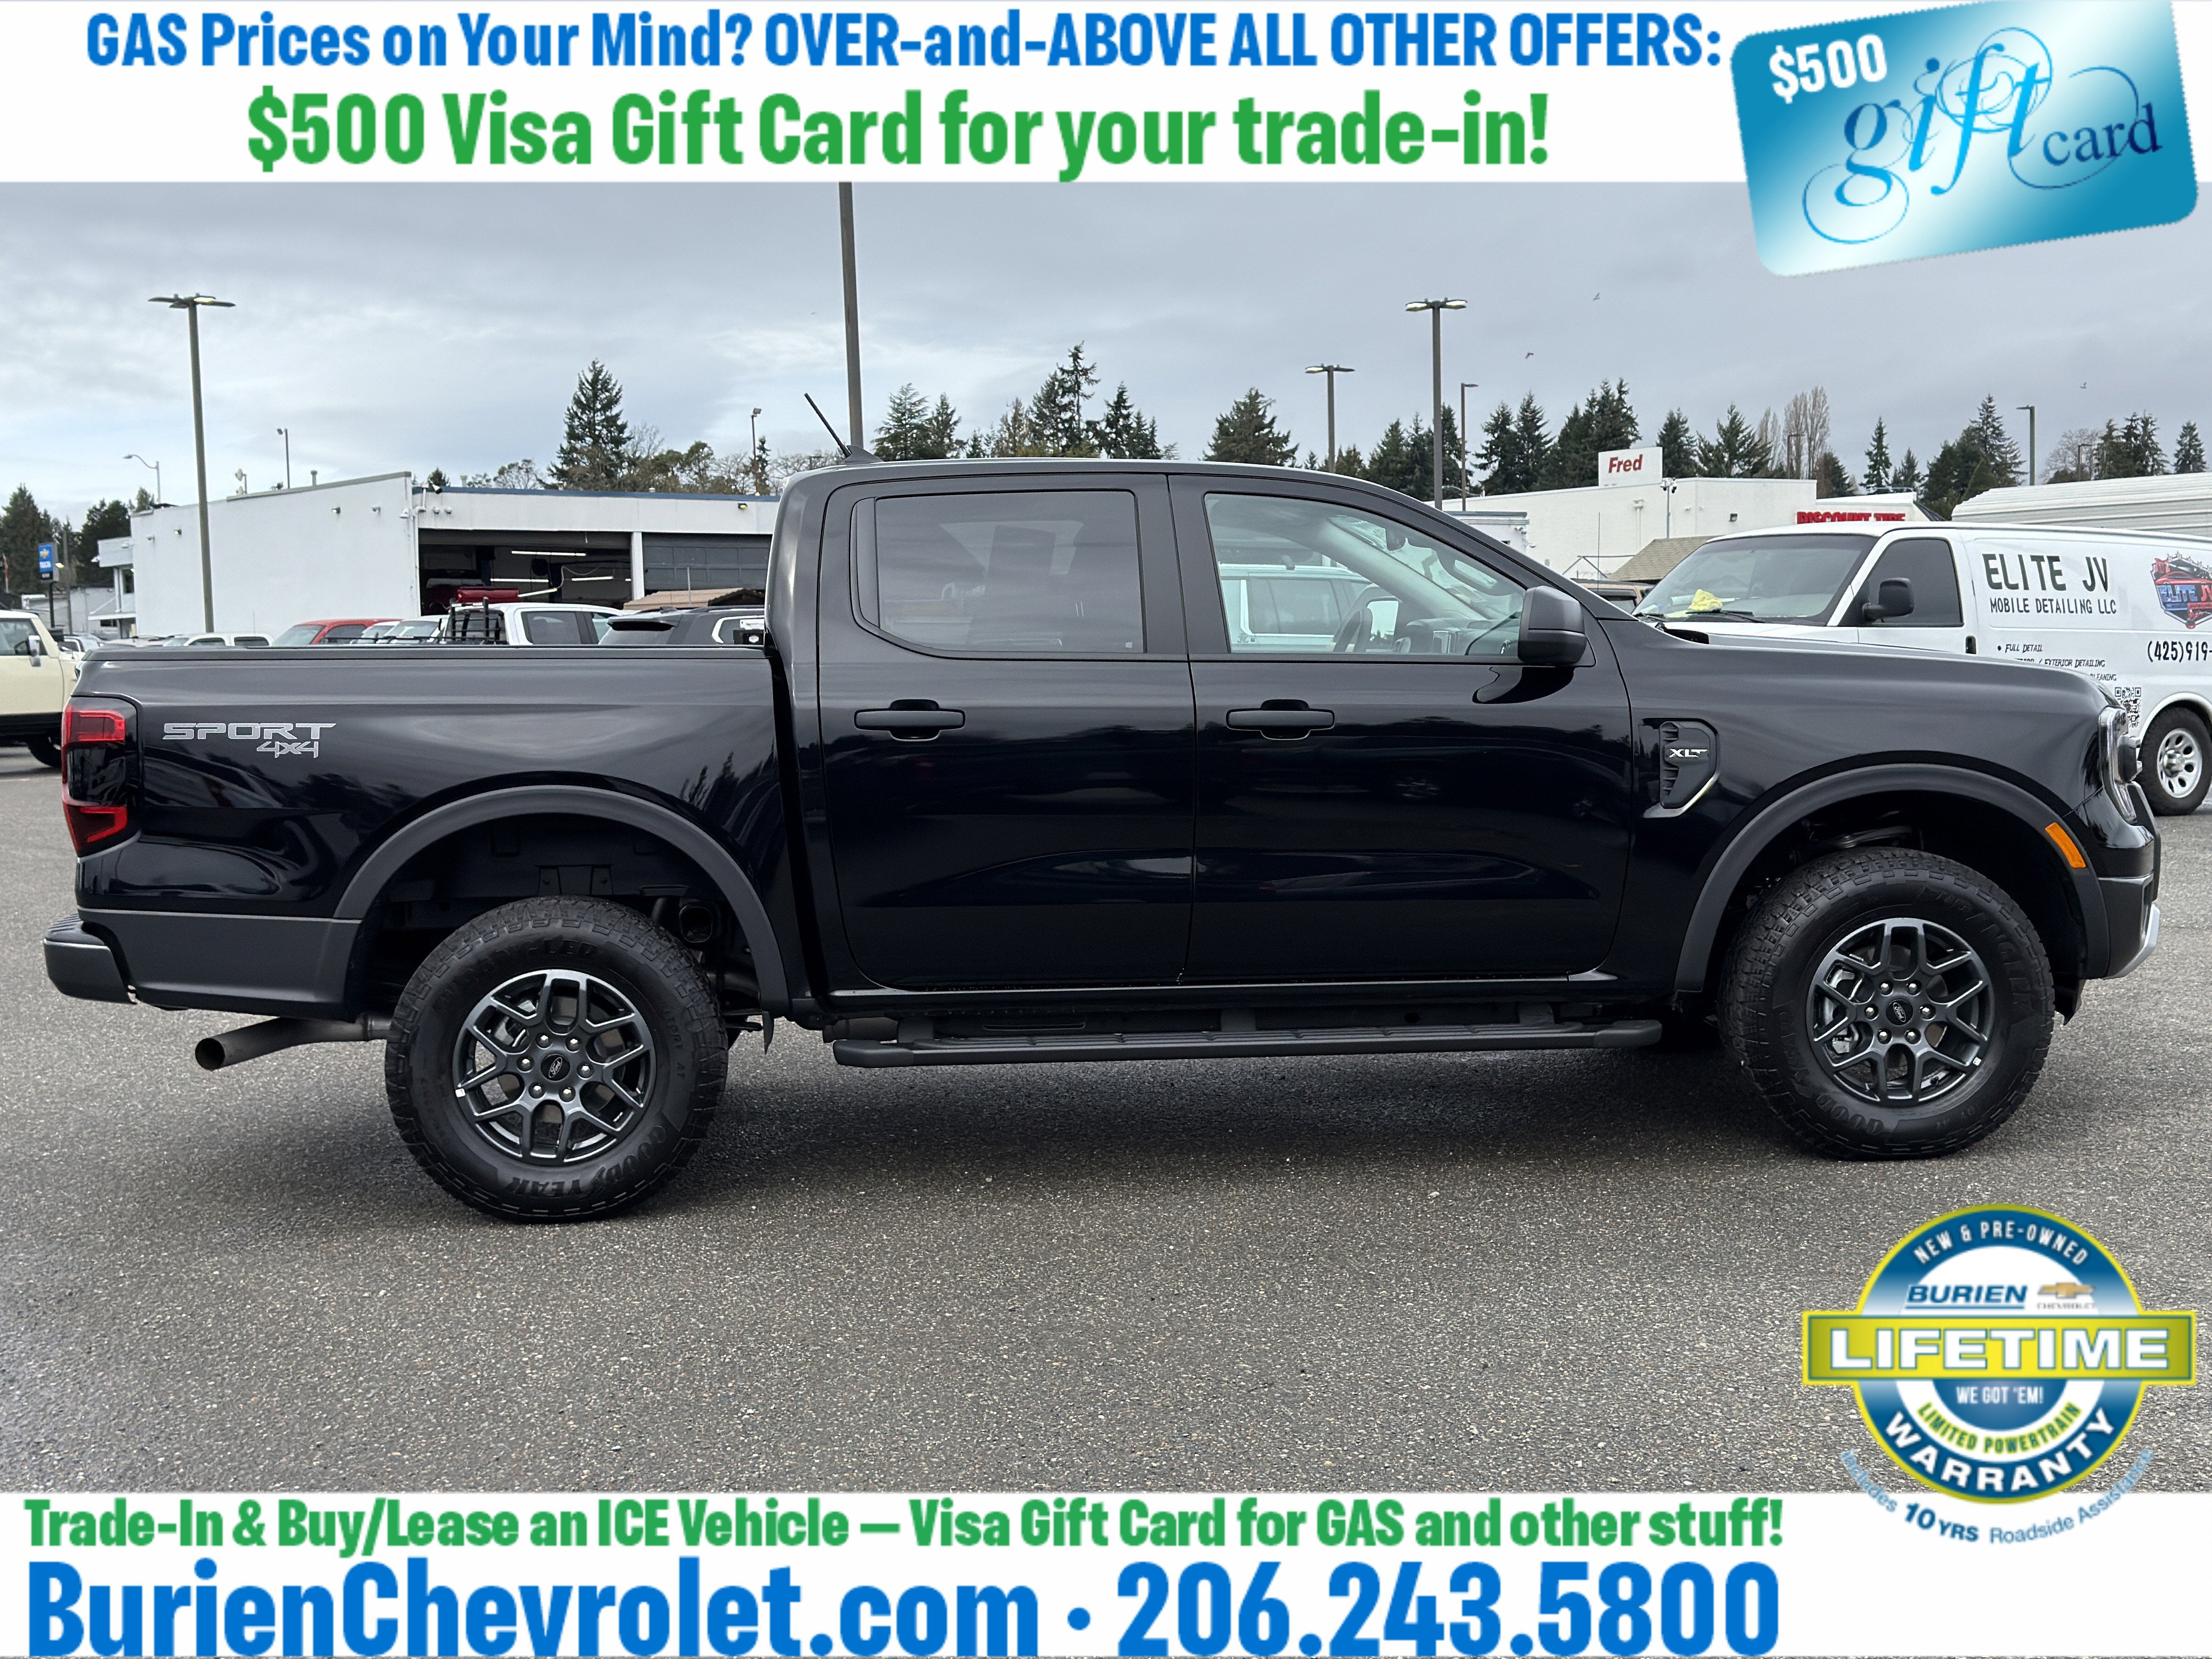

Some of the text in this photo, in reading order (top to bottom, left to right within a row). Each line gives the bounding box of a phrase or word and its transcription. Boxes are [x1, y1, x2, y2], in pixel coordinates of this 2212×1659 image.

[1608, 454, 1643, 473] Fred
[1982, 553, 2109, 593] ELITE JV
[2157, 584, 2198, 602] ELITE
[1990, 597, 2117, 615] MOBILE DETAILING LLC
[2005, 644, 2043, 653] FULL DETAIL
[2074, 659, 2105, 668] DETAILING
[163, 723, 336, 739] SPORT
[1669, 749, 1708, 758] XLT
